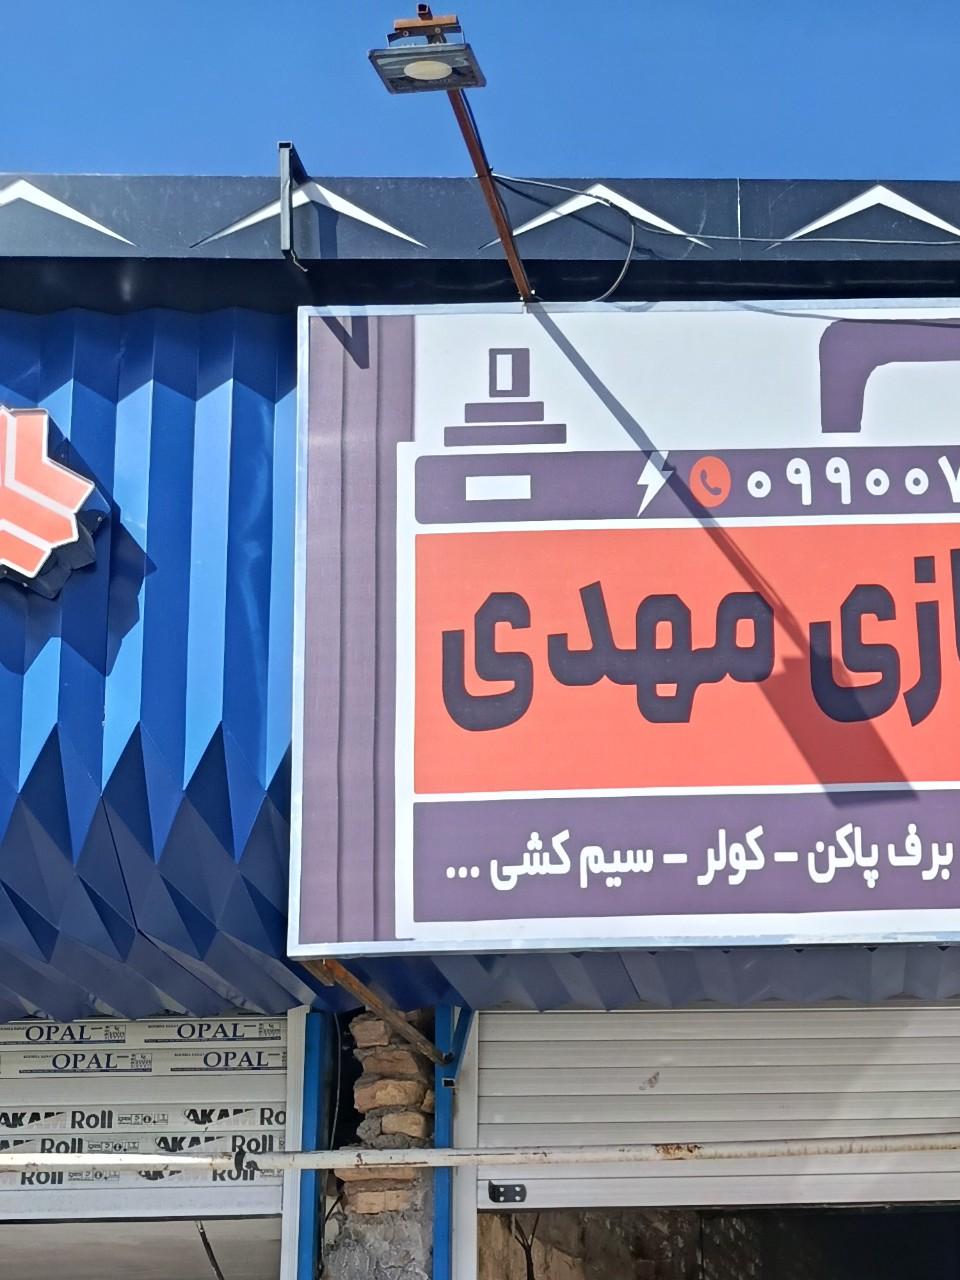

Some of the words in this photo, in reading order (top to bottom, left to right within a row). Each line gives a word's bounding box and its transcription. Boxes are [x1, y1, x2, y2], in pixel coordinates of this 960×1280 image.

[442, 583, 776, 732] مهدی
[489, 828, 572, 892] کشی
[696, 824, 766, 887] کولر
[807, 822, 879, 889] پاکن
[887, 823, 954, 882] برف
[579, 845, 654, 890] سیم
[25, 1024, 92, 1041] OPAL
[177, 1022, 245, 1039] OPAL
[51, 1053, 118, 1070] OPAL
[203, 1050, 269, 1067] OPAL
[71, 1110, 113, 1129] Roll
[40, 1137, 83, 1154] Roll
[231, 1134, 273, 1153] Roll
